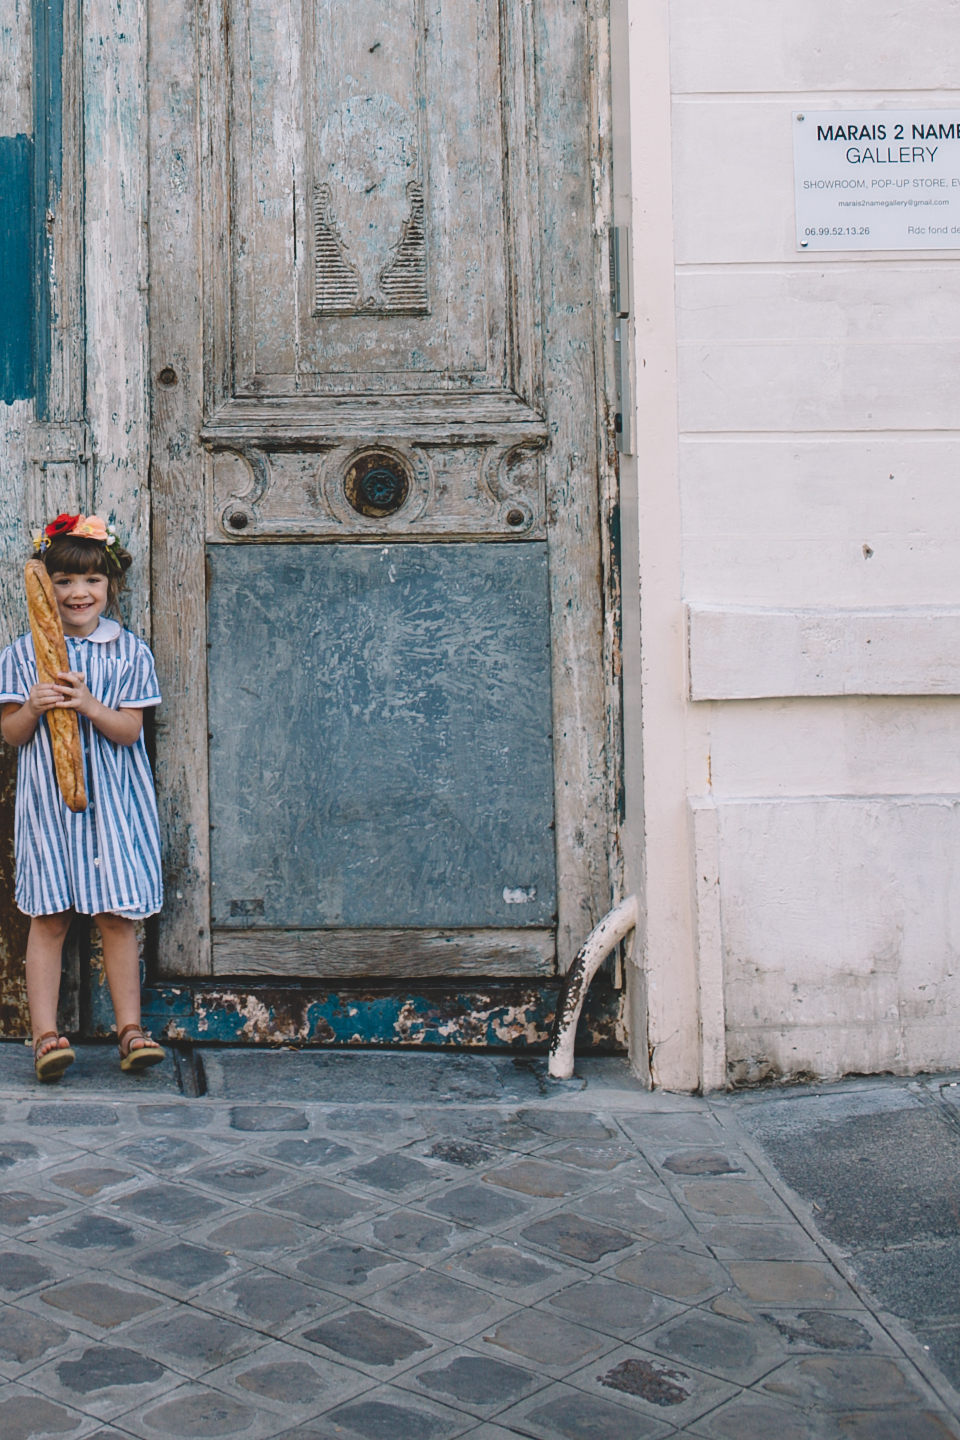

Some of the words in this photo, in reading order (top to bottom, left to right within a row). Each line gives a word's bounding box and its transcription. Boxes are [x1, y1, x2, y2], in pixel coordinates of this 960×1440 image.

[817, 124, 887, 141] MARAIS
[894, 124, 904, 140] 2
[845, 146, 938, 164] GALLERY
[803, 179, 869, 190] SHOWROOM,
[871, 179, 910, 189] POP-UP
[912, 178, 949, 189] STORE,
[951, 178, 960, 188] E
[838, 199, 949, 208] marais2namegallery@gmail.com
[804, 227, 870, 236] 06.99.52.13.26
[907, 226, 926, 235] Rdc
[928, 225, 948, 235] fond
